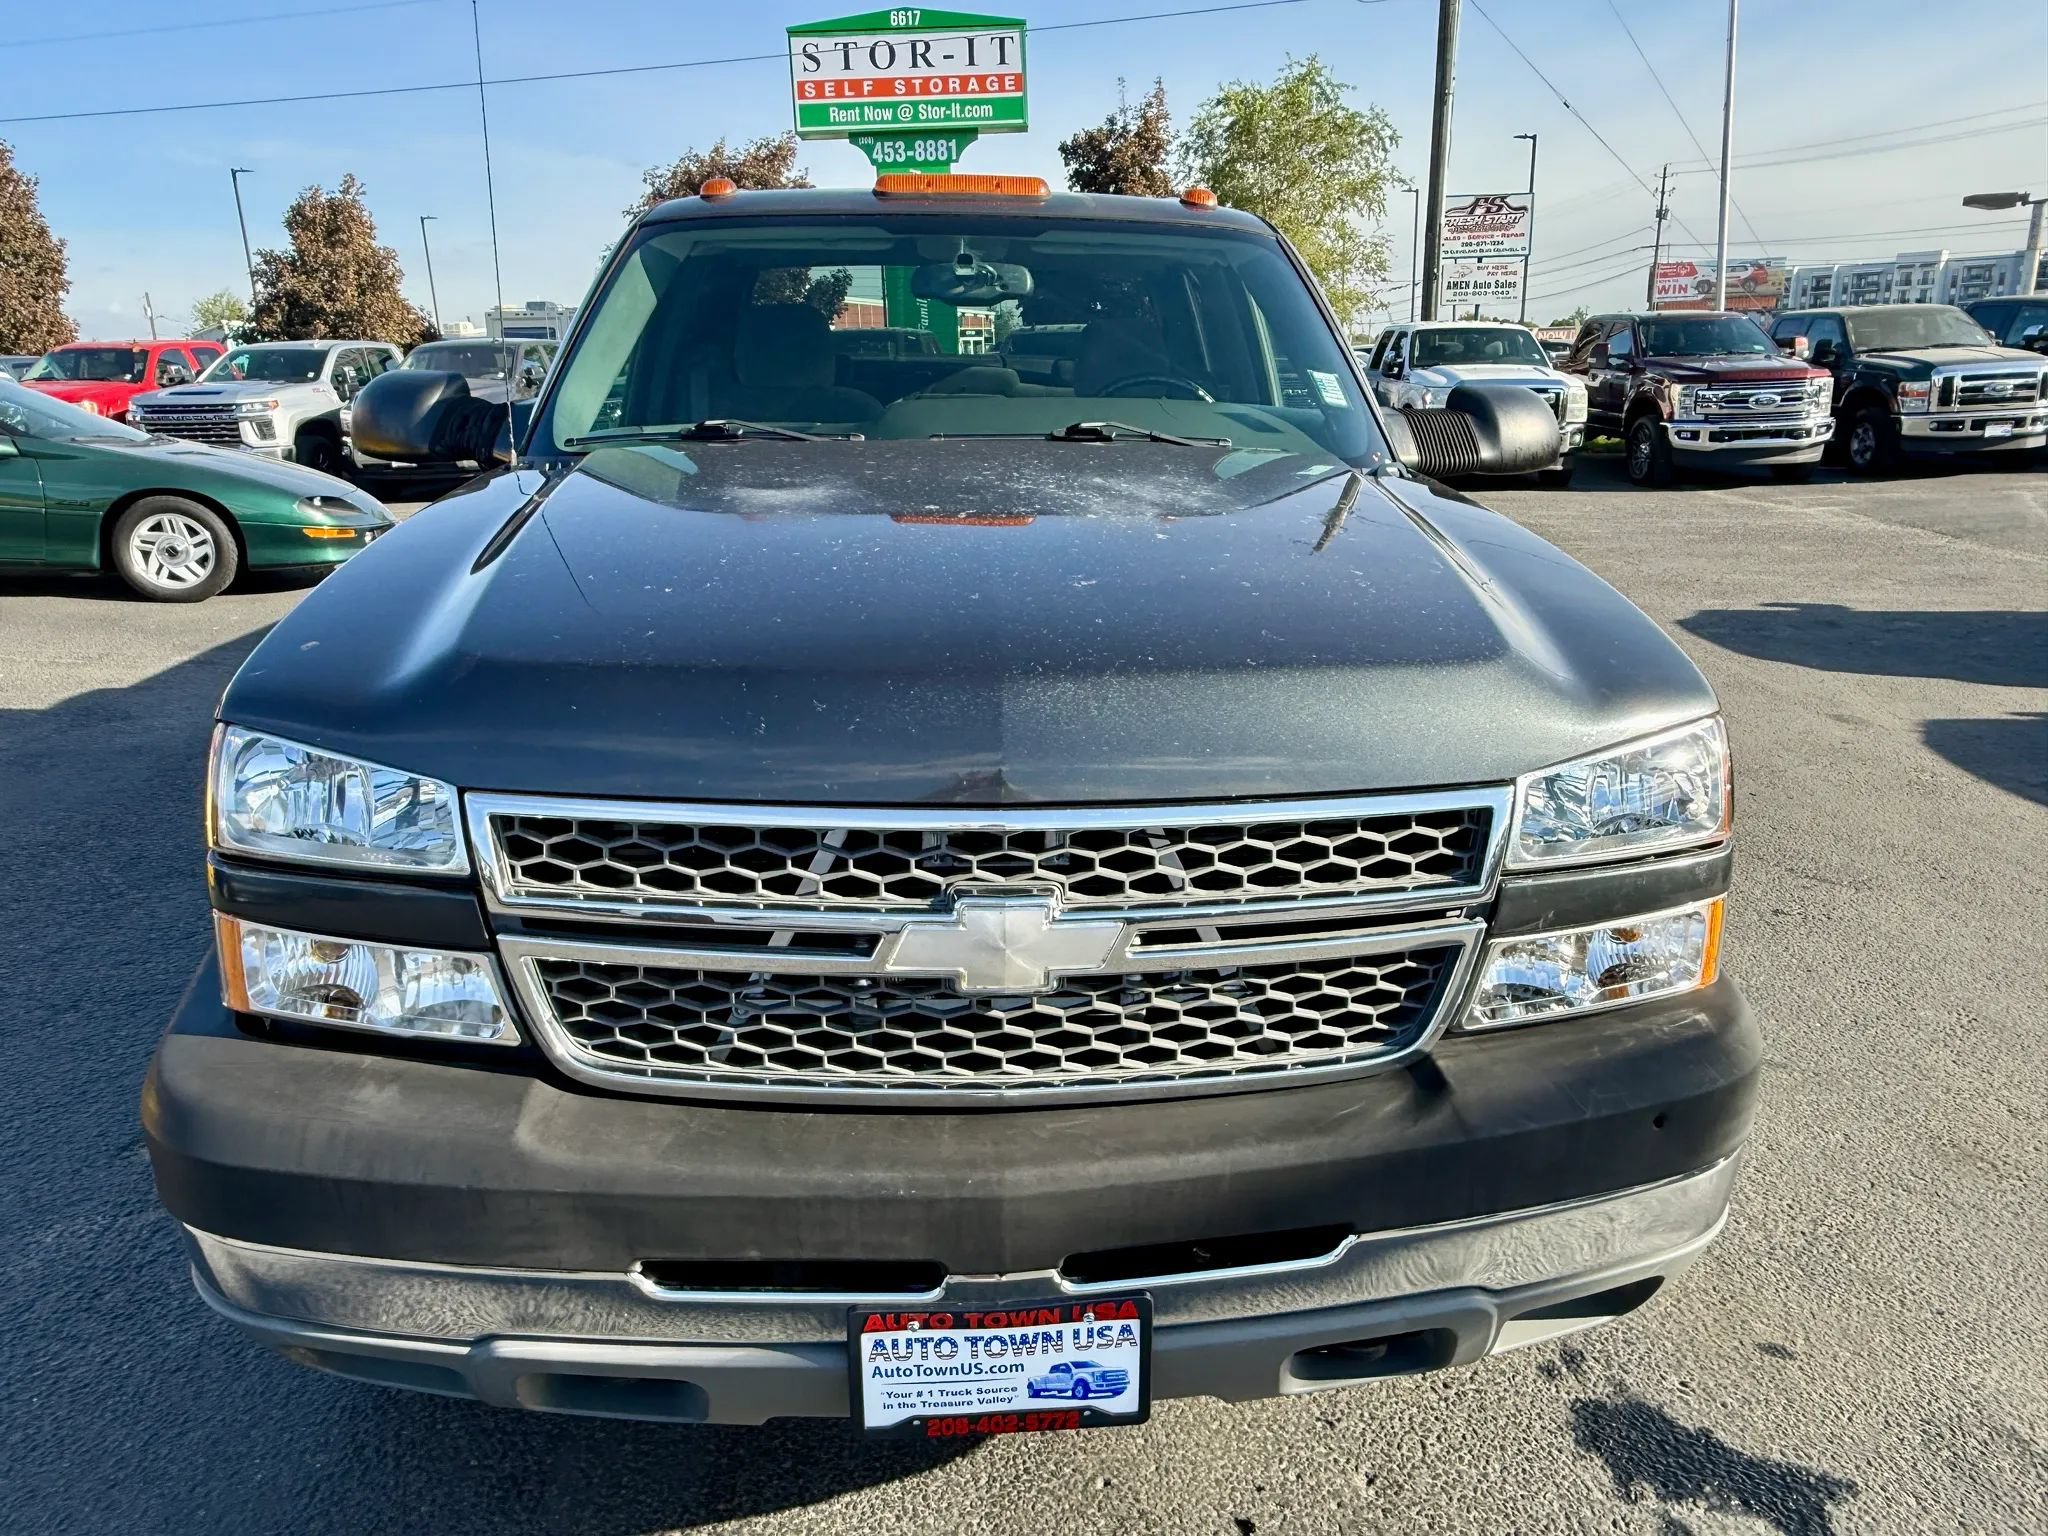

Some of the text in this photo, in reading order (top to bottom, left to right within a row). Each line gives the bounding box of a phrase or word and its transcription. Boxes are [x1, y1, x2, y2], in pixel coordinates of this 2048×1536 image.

[890, 10, 921, 27] 6617
[802, 36, 1015, 73] STOR-IT
[804, 75, 1016, 98] SELF STORAGE
[829, 103, 993, 122] Rent Now @ Stor-It.com
[872, 139, 957, 163] 453-8881
[1446, 279, 1517, 291] AMEN Auto Sales
[1657, 284, 1689, 296] WIN
[863, 1300, 1139, 1332] AUTO TOWN USA
[868, 1323, 1139, 1363] AUTO TOWN USA
[871, 1362, 1025, 1379] AutoTownUS.com
[916, 1390, 925, 1398] #
[927, 1389, 934, 1398] 1
[937, 1387, 973, 1398] Truck
[976, 1385, 1019, 1396] Source
[882, 1401, 895, 1410] in
[898, 1400, 917, 1410] the
[920, 1398, 974, 1409] Treasure
